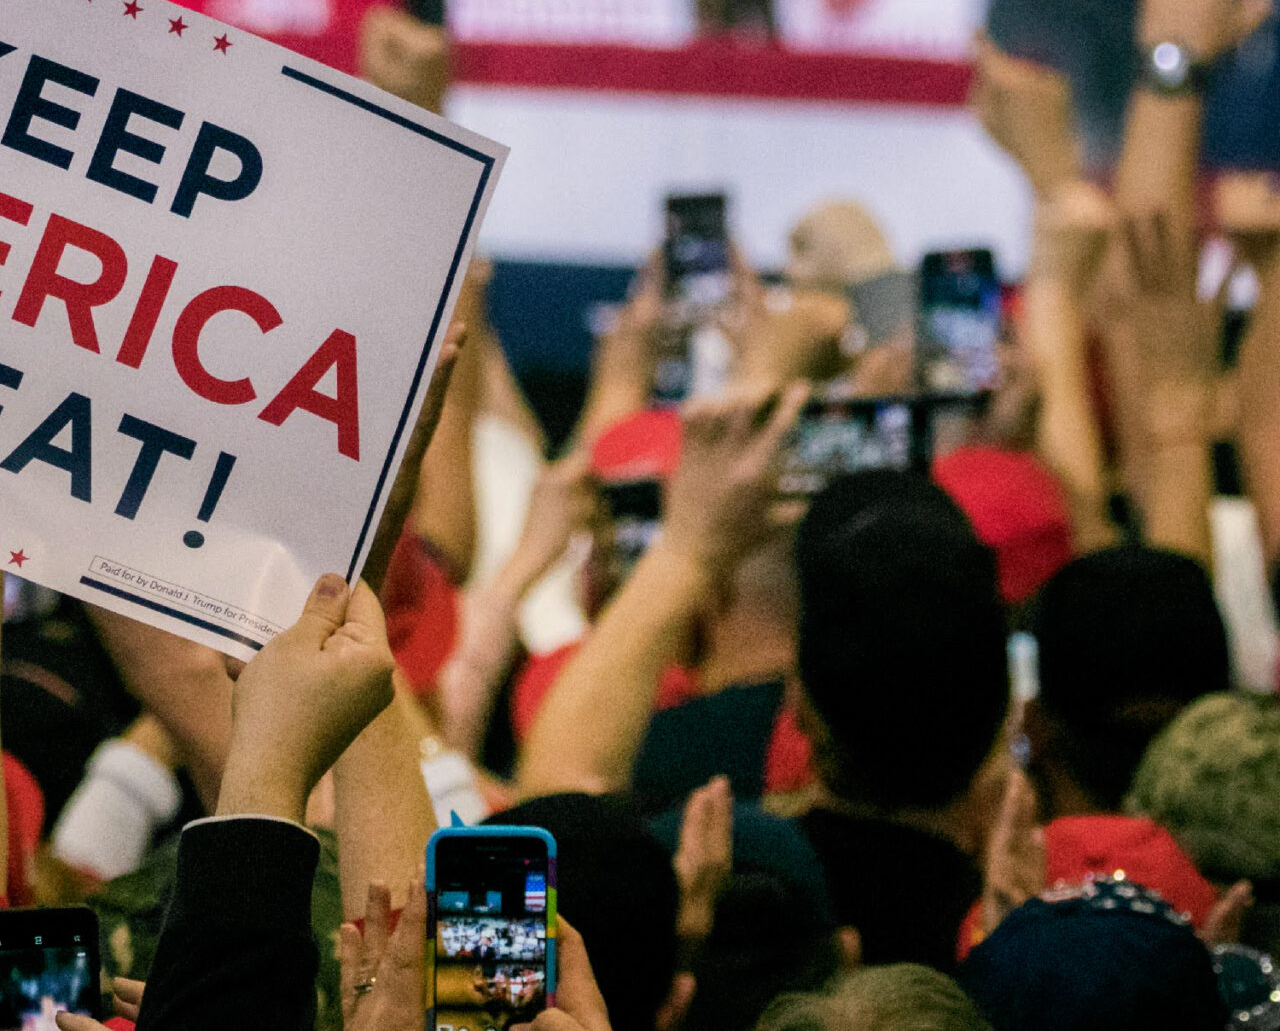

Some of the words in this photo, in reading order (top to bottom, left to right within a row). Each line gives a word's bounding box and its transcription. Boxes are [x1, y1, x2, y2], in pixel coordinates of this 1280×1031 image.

[100, 561, 122, 576] Paid
[122, 569, 135, 581] for
[136, 575, 149, 587] by
[149, 580, 183, 599] Donald
[193, 594, 223, 614] Trump
[224, 607, 237, 619] for
[238, 613, 278, 637] Presiden
